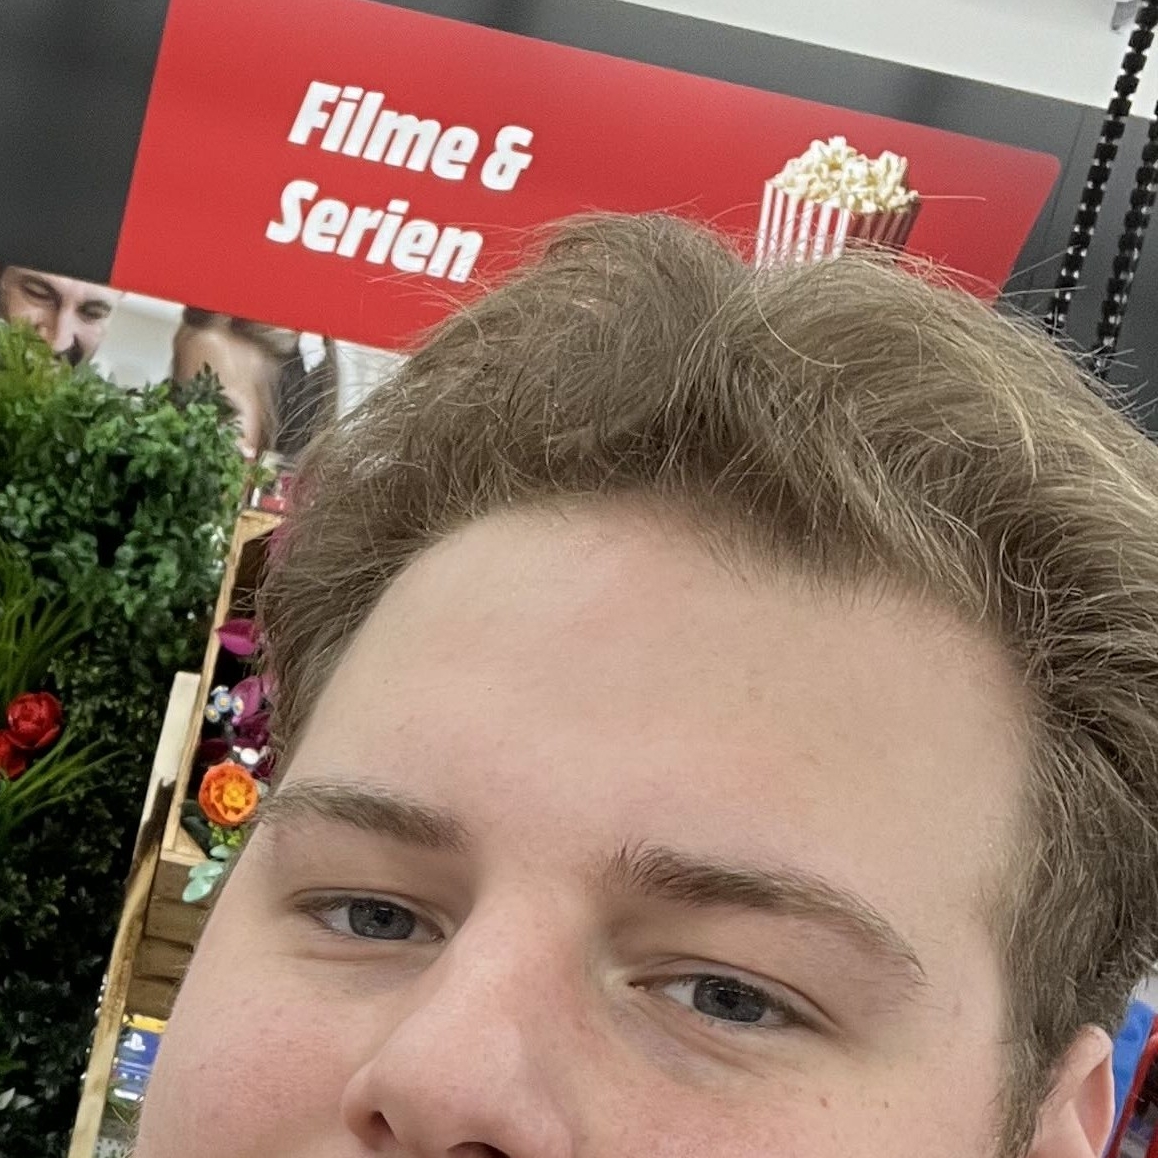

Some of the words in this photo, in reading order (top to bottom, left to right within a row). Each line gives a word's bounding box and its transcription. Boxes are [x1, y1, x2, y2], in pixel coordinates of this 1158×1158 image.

[287, 80, 479, 181] Filme
[480, 125, 534, 191] &
[265, 179, 484, 284] Serien
